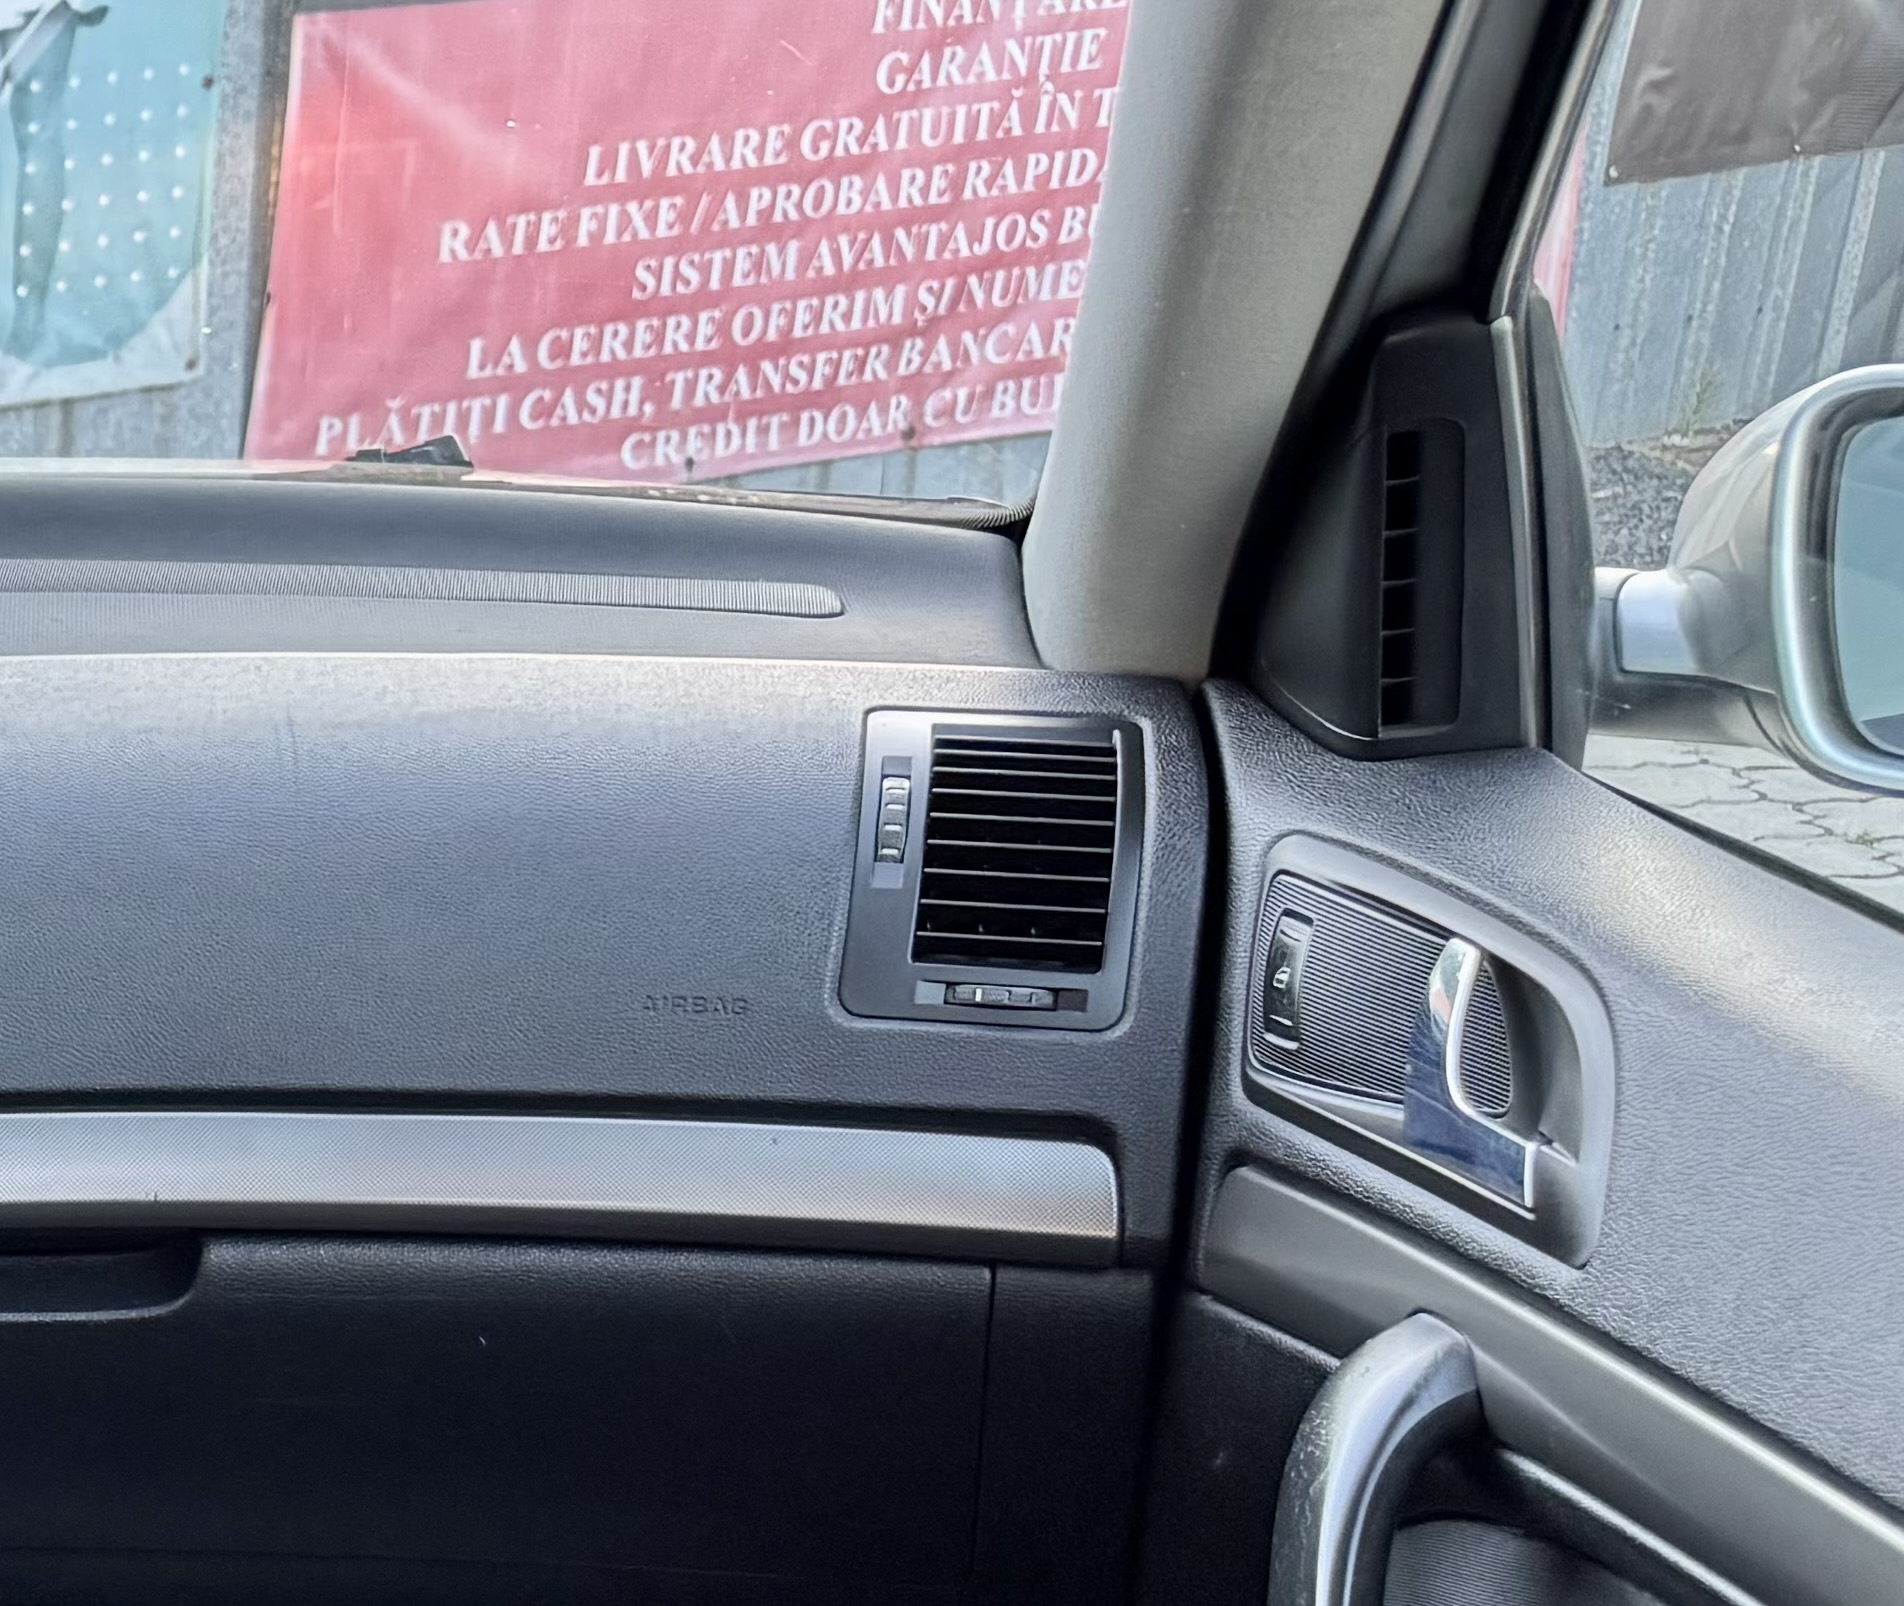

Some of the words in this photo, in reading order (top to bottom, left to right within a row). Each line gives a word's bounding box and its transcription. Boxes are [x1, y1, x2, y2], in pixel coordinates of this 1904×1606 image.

[876, 28, 1107, 94] GARANȚIE
[582, 123, 792, 187] LIVRARE
[799, 88, 1024, 162] GRATUITĂ
[438, 207, 567, 264] RATE
[576, 195, 685, 248] FIXE
[711, 163, 955, 232] APROBARE
[962, 148, 1107, 200] RAPID
[632, 239, 803, 300] SISTEM
[806, 208, 1052, 278] AVANTAJOS
[465, 333, 529, 380] LA
[537, 306, 725, 371] CERERE
[731, 282, 909, 347] OFERIM
[518, 375, 655, 430] CASH,
[665, 344, 890, 411] TRANSFER
[621, 411, 789, 470] CREDIT
[798, 394, 912, 446] DOAR
[923, 384, 984, 428] CU
